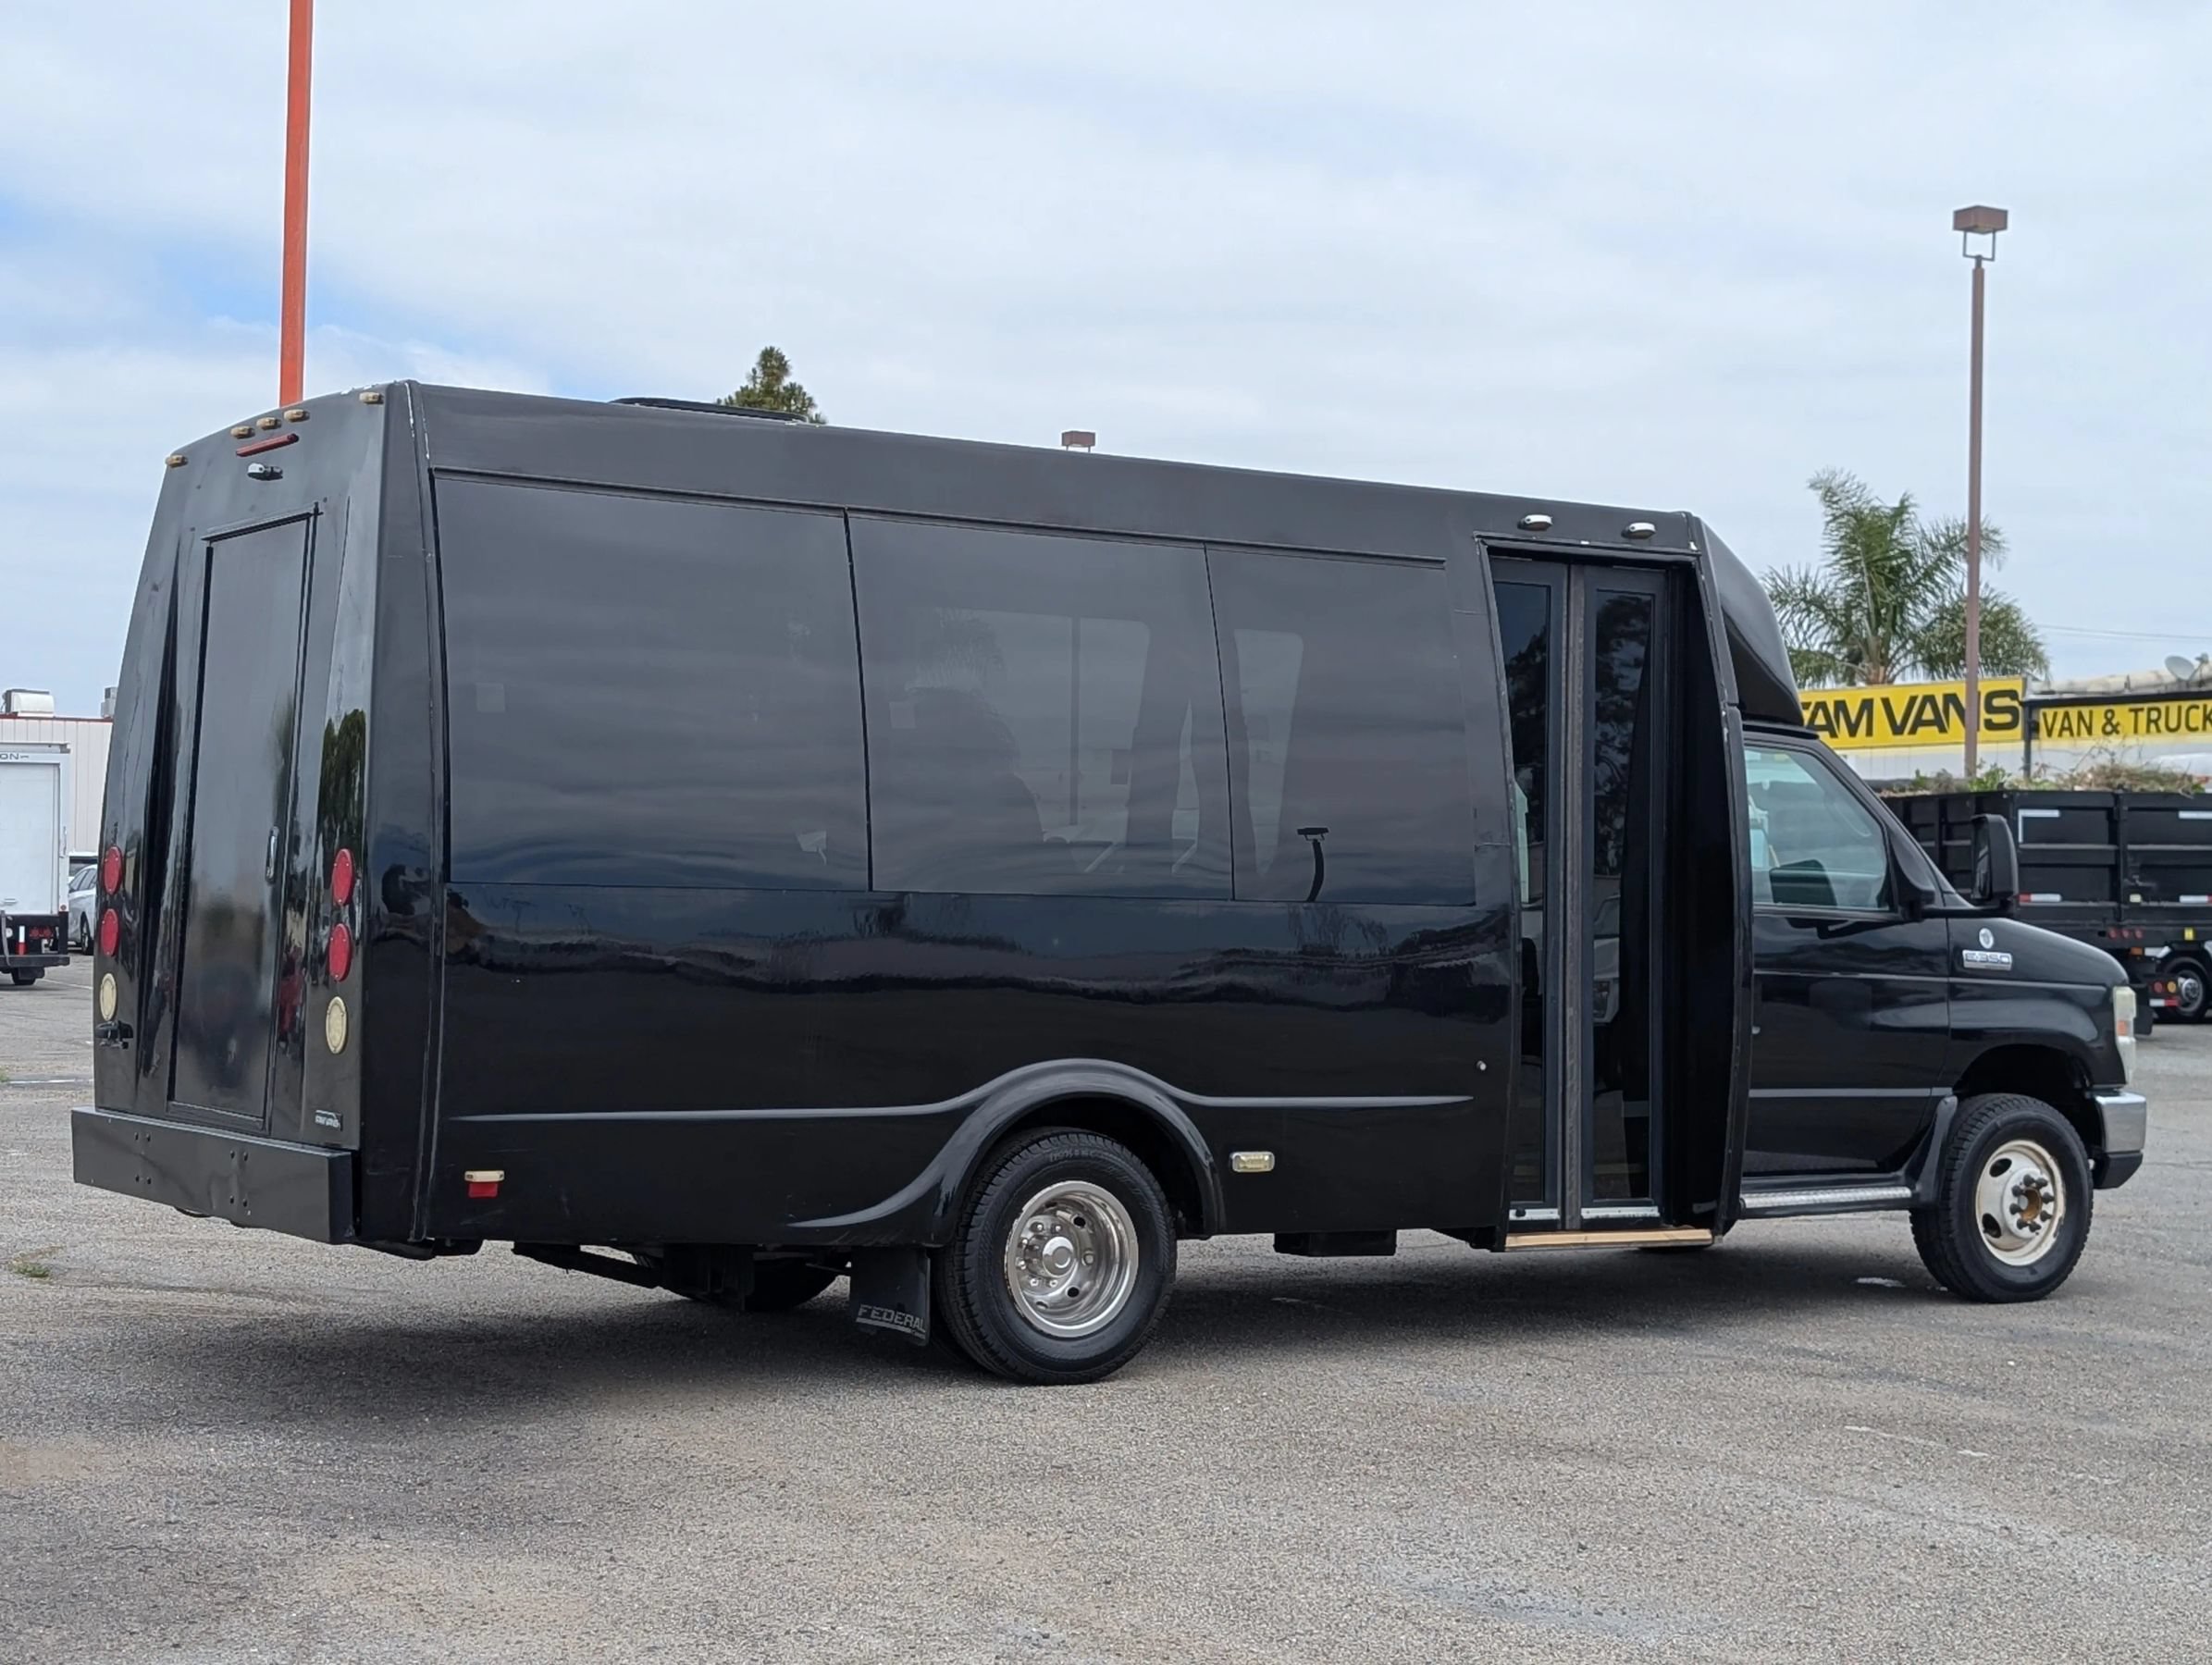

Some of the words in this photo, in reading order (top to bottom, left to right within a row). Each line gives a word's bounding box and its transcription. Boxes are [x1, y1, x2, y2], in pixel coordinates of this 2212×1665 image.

[1800, 698, 1874, 739] AM
[1881, 689, 2020, 736] VANS
[2042, 709, 2094, 737] VAN
[2101, 709, 2120, 735] &
[2128, 704, 2212, 734] TRUCK
[859, 1303, 926, 1333] FEDERAL
